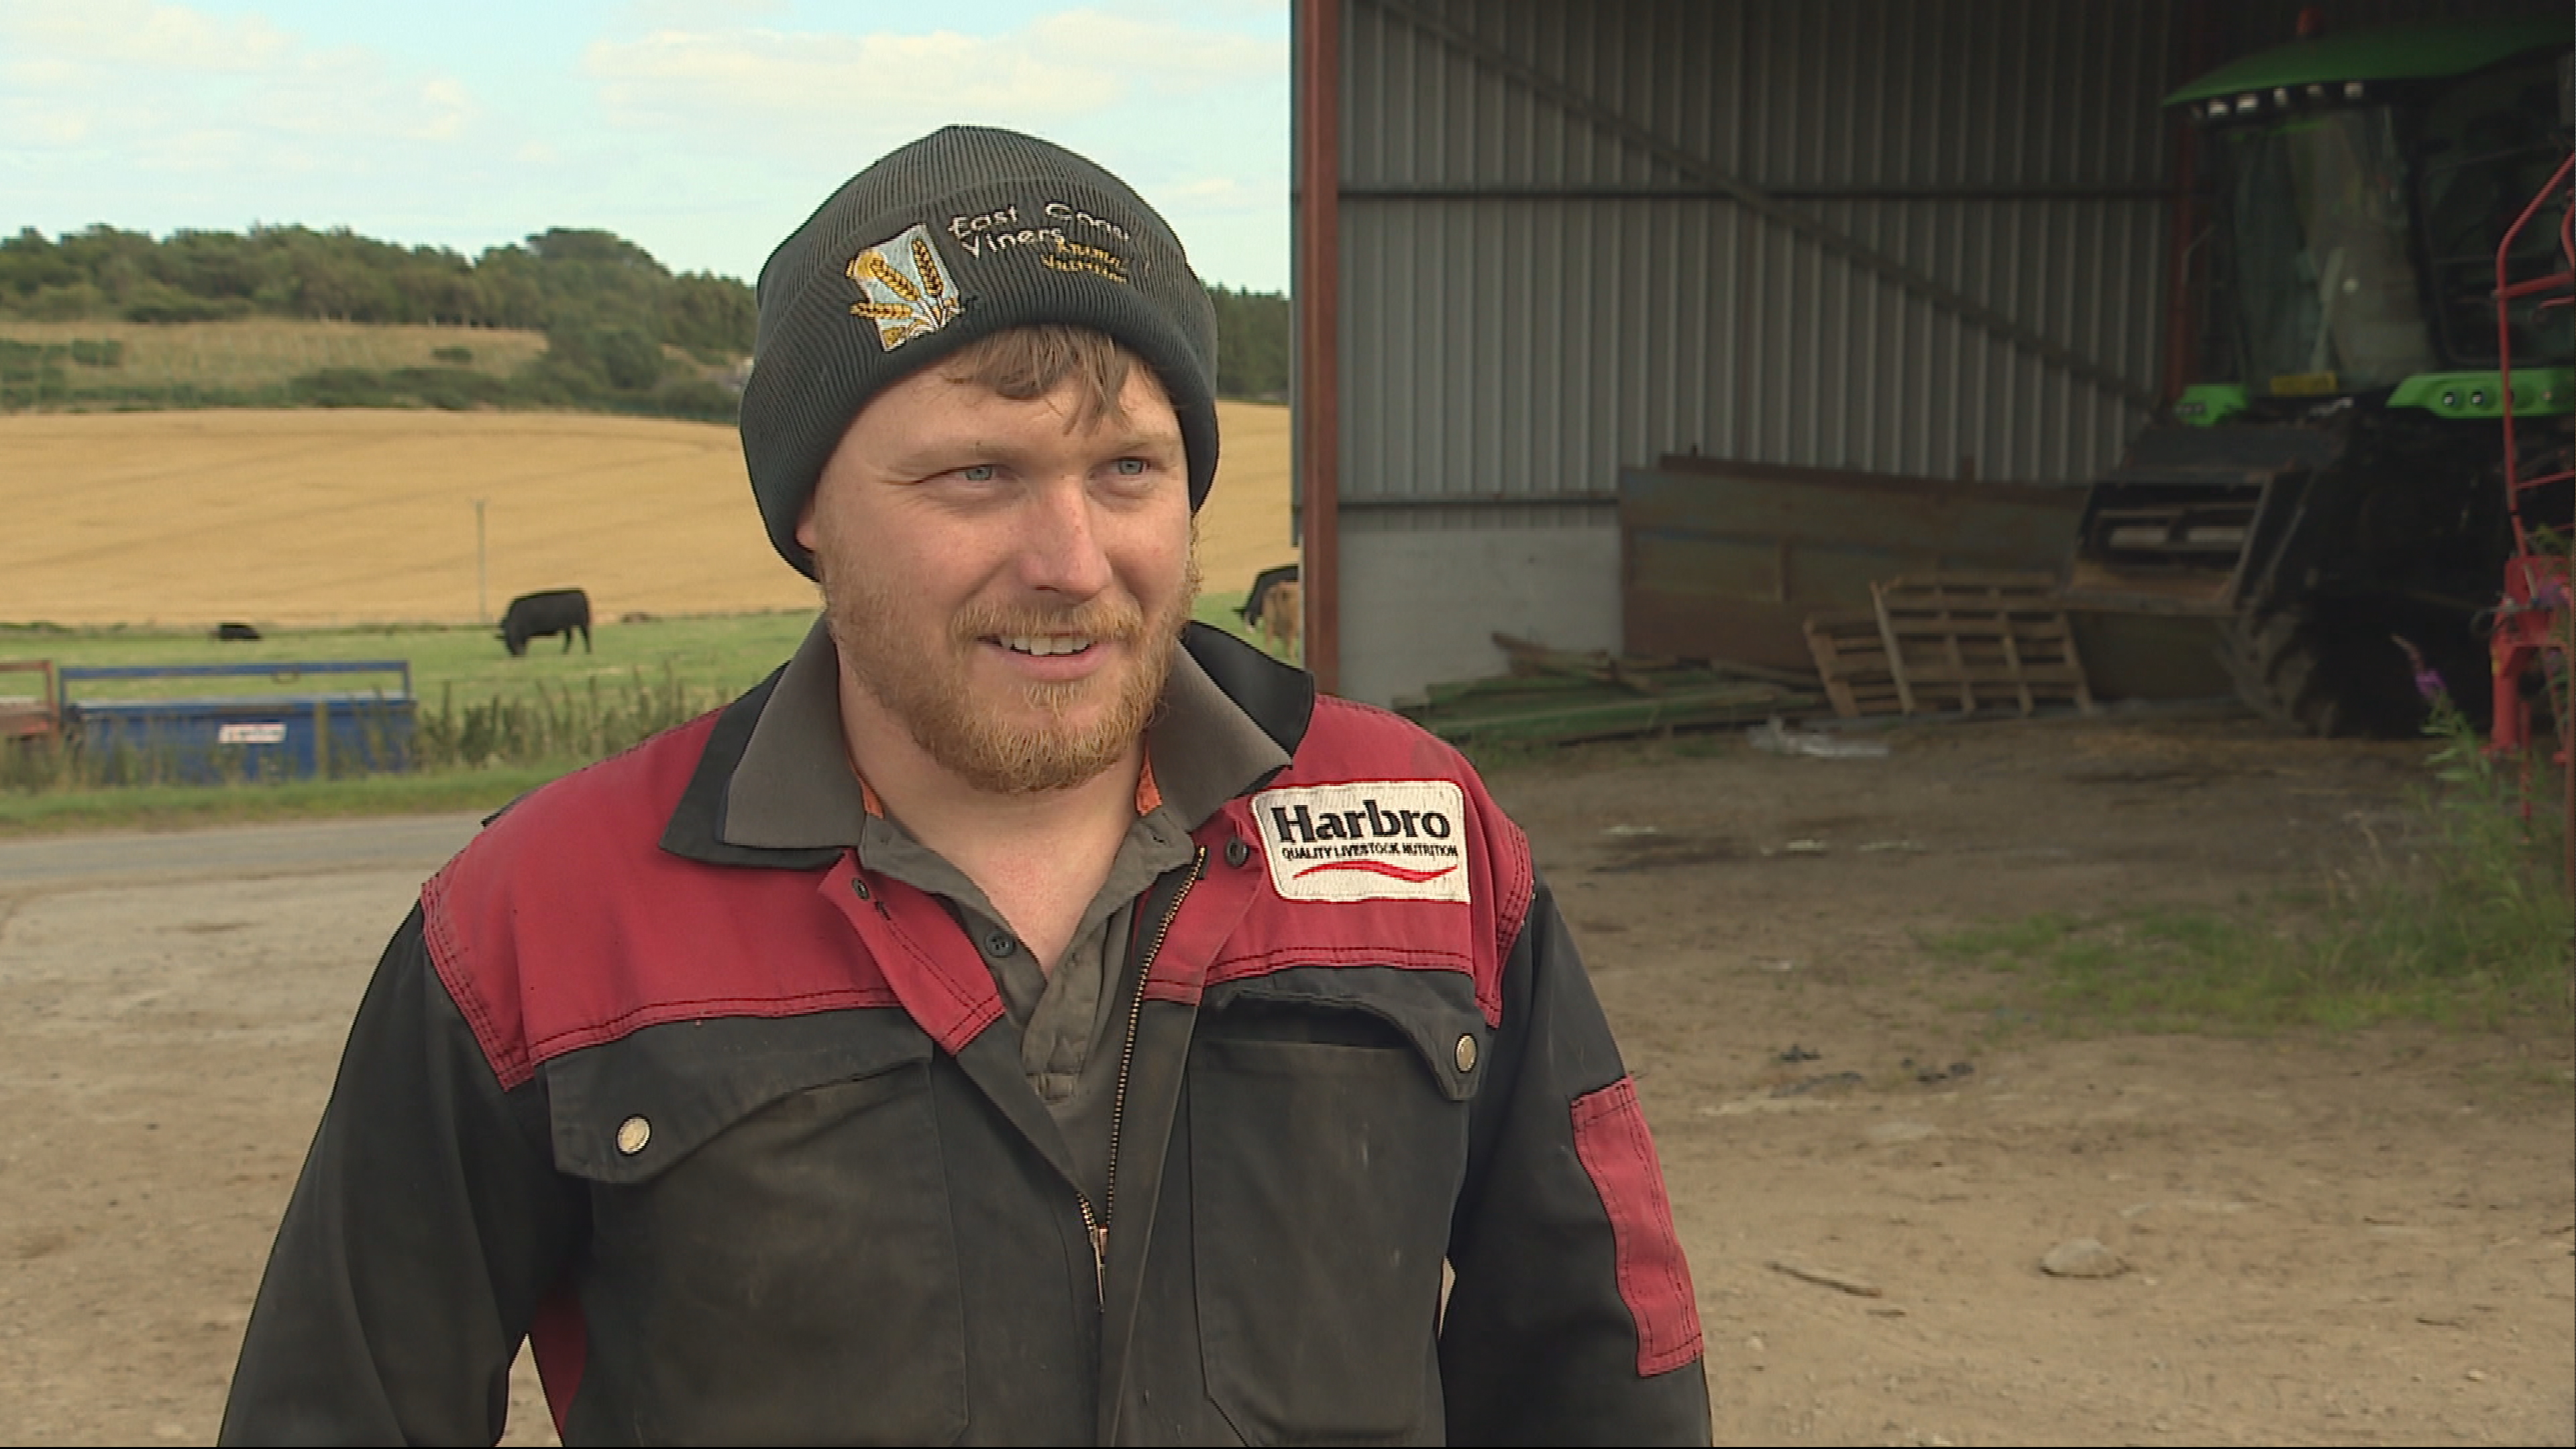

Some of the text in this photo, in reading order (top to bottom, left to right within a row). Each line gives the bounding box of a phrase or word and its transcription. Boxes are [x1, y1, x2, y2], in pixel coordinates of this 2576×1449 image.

[947, 205, 1018, 239] East
[1271, 799, 1452, 843] Harbro
[1281, 842, 1459, 861] QUALITY LIVESTOCK NUTRITION
